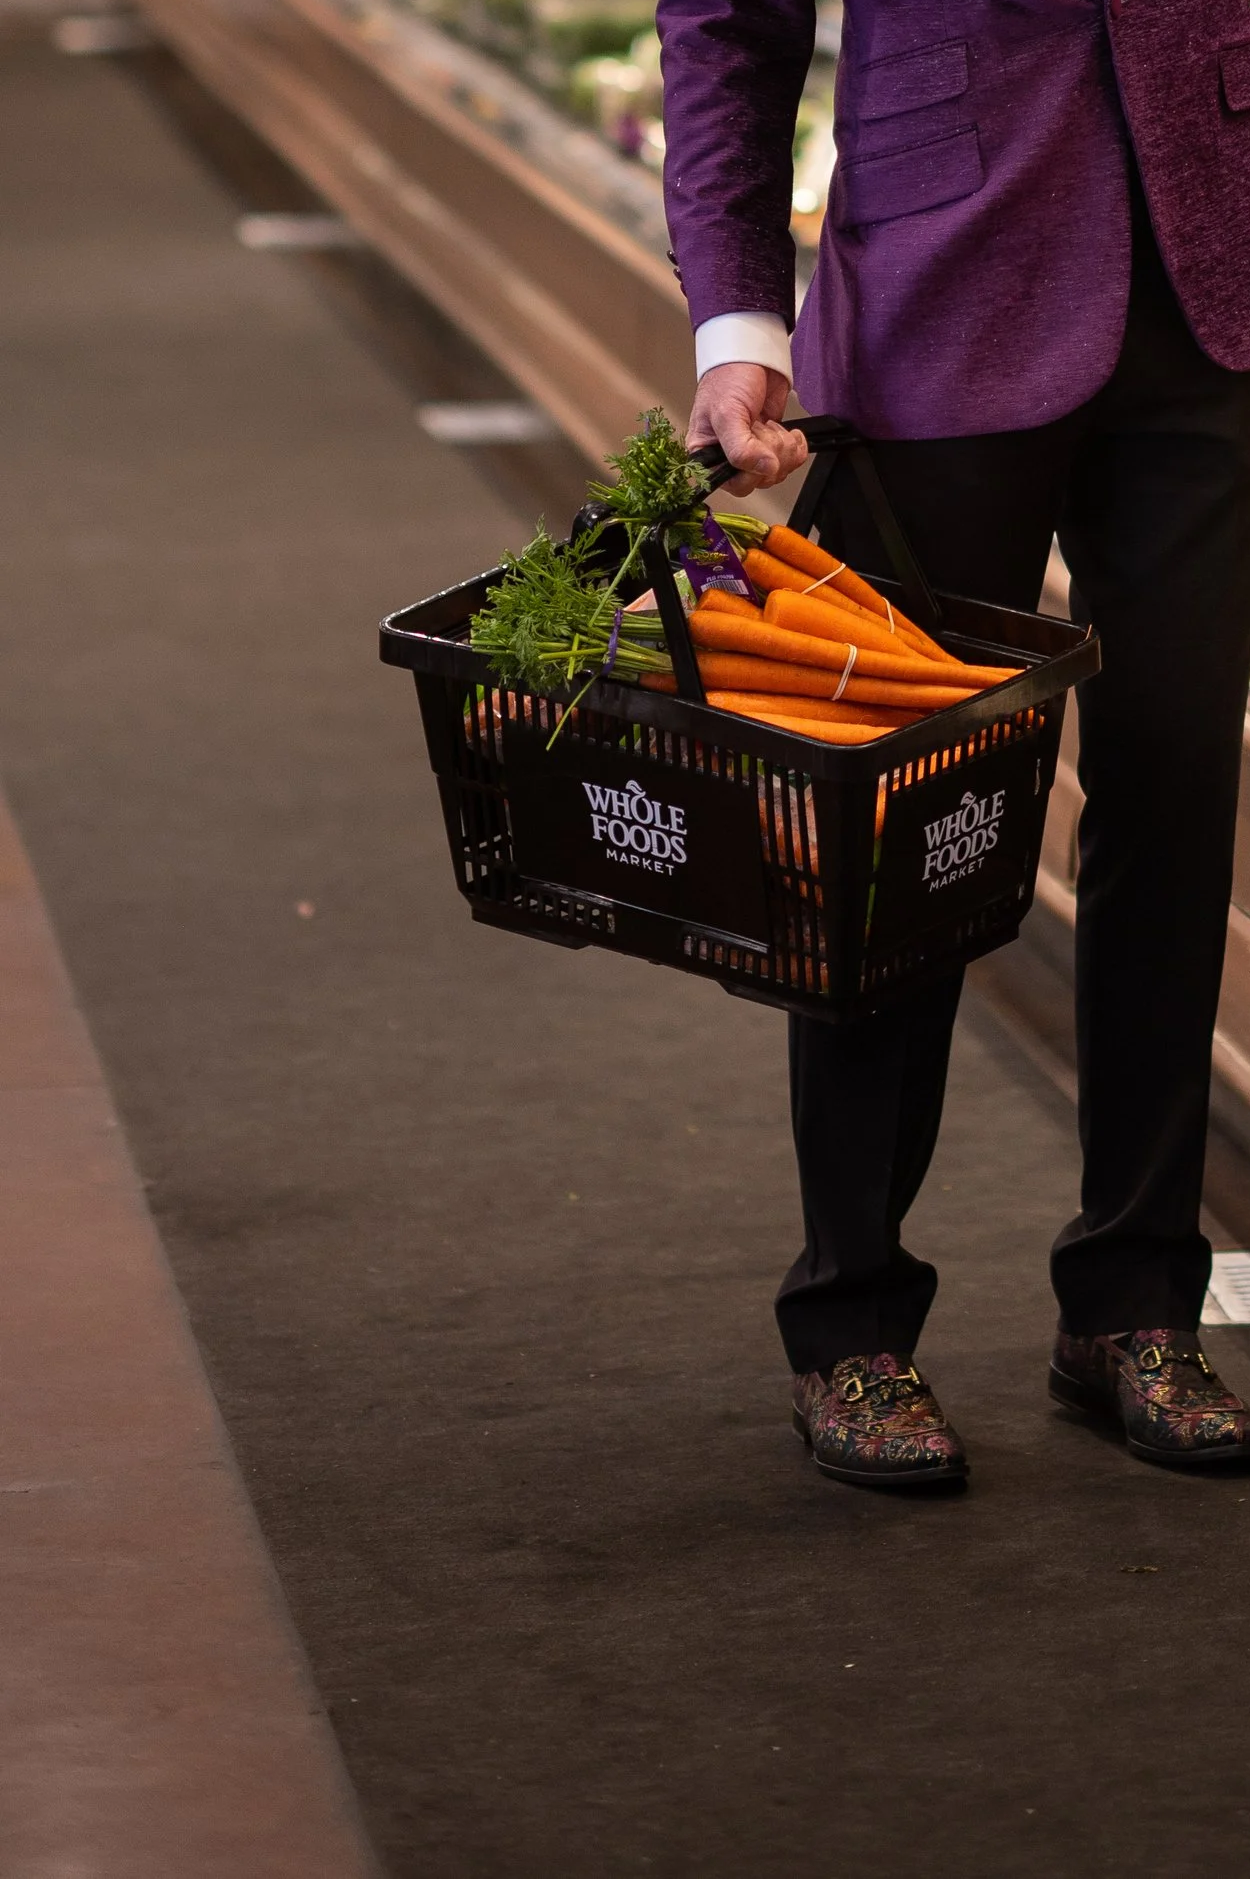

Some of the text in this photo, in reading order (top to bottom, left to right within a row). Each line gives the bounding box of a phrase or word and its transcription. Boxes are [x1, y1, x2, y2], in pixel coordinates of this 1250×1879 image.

[582, 780, 688, 835] WHOLE
[924, 790, 1006, 850] WHOLE
[590, 813, 688, 864] FOODS
[606, 848, 675, 876] MARKET
[922, 821, 1000, 881] FOODS
[929, 857, 986, 893] MARKET
